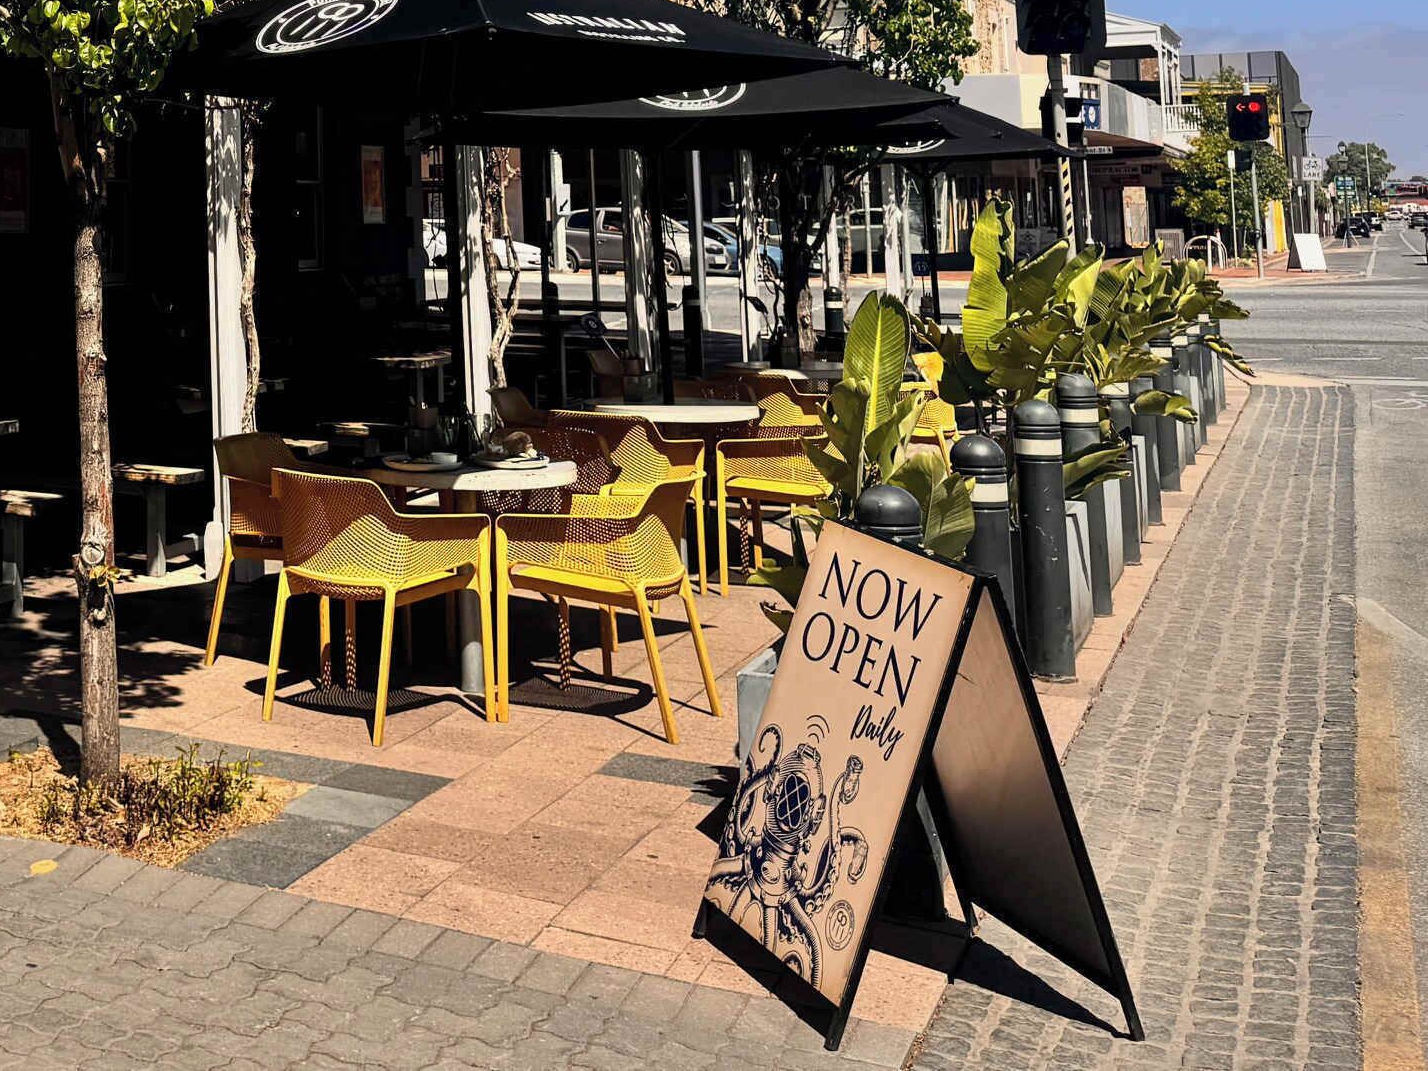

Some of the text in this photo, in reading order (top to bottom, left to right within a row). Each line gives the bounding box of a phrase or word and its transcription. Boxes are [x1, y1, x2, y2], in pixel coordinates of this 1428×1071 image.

[818, 552, 943, 641] NOW
[802, 612, 921, 707] OPEN
[850, 704, 905, 761] Daily
